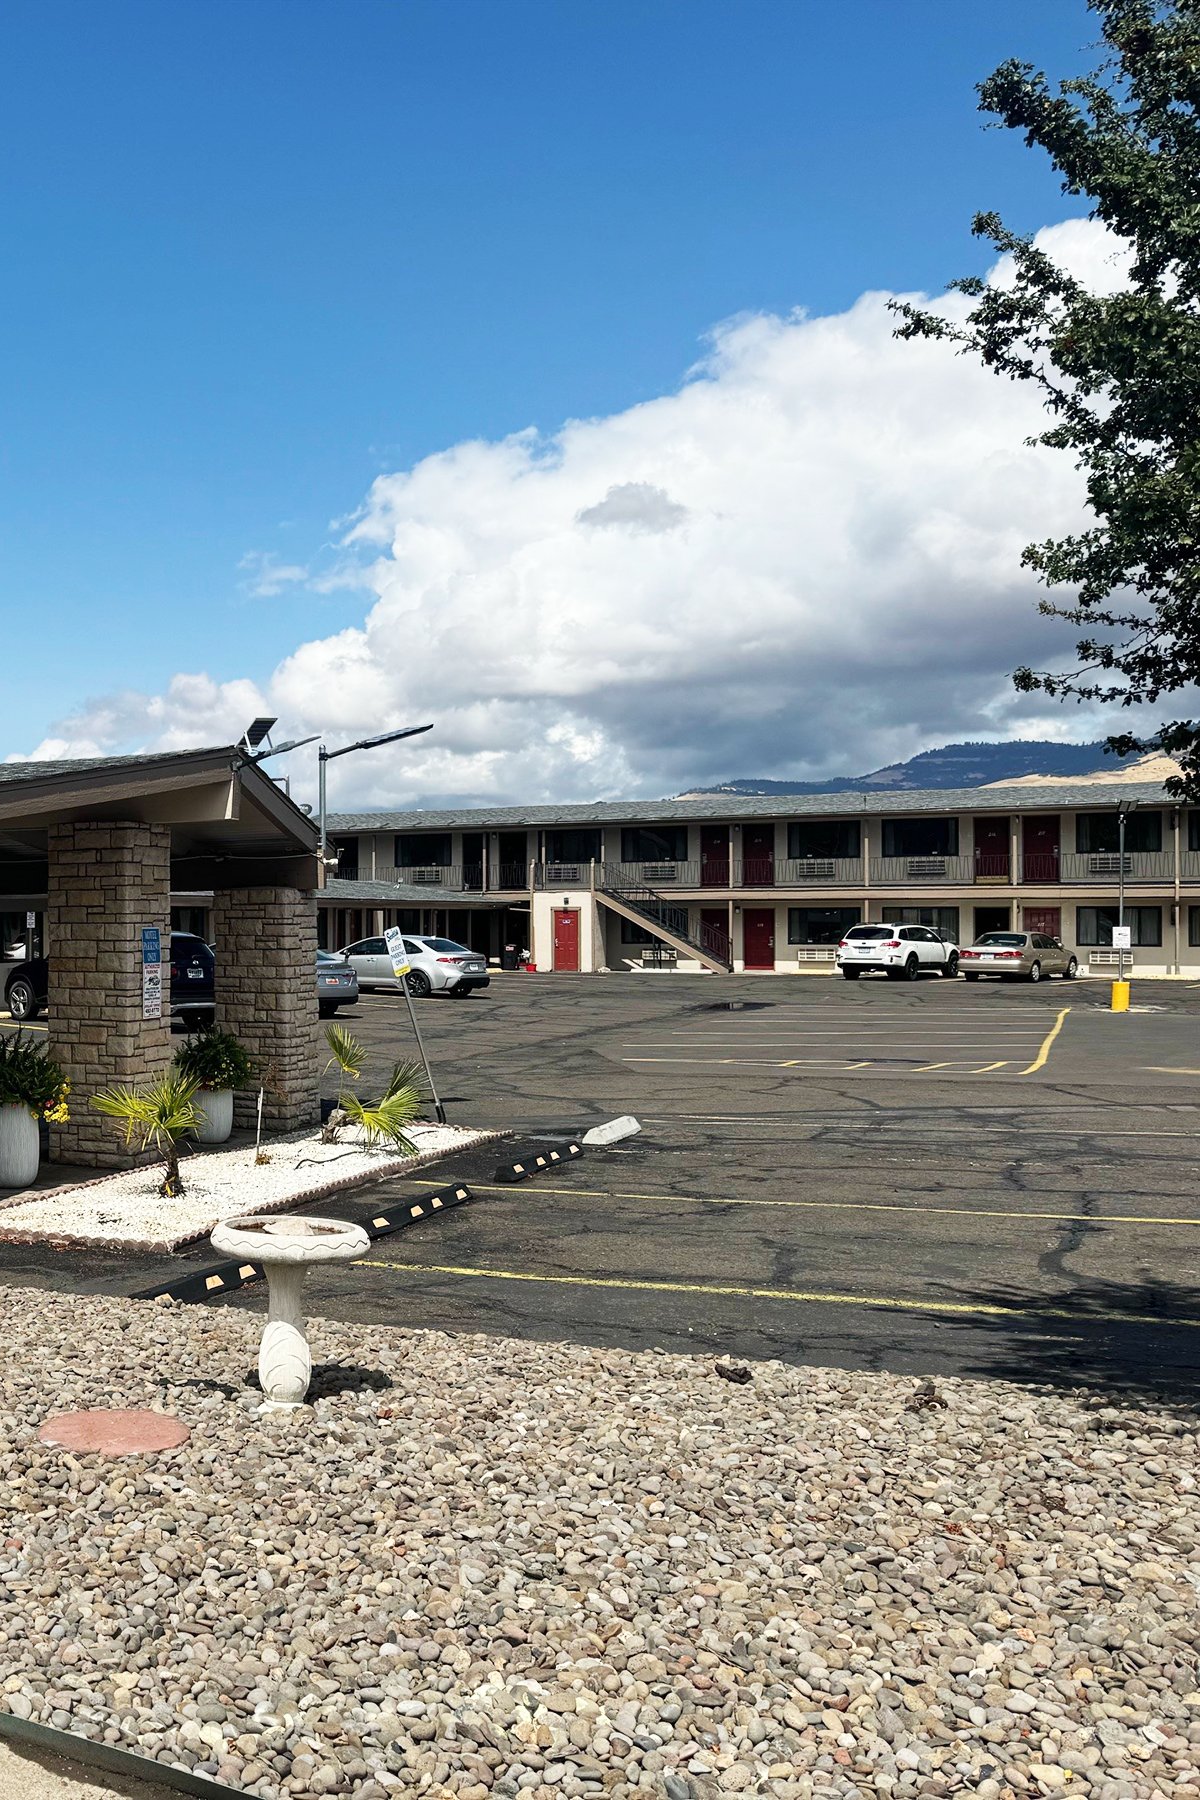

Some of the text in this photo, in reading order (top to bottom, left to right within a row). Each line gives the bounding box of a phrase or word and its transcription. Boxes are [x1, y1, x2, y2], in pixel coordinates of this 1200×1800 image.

[144, 930, 157, 940] MOTEL
[143, 941, 160, 950] PARKING
[390, 944, 401, 953] GUEST
[147, 952, 157, 962] ONLY
[390, 950, 405, 960] PARKING
